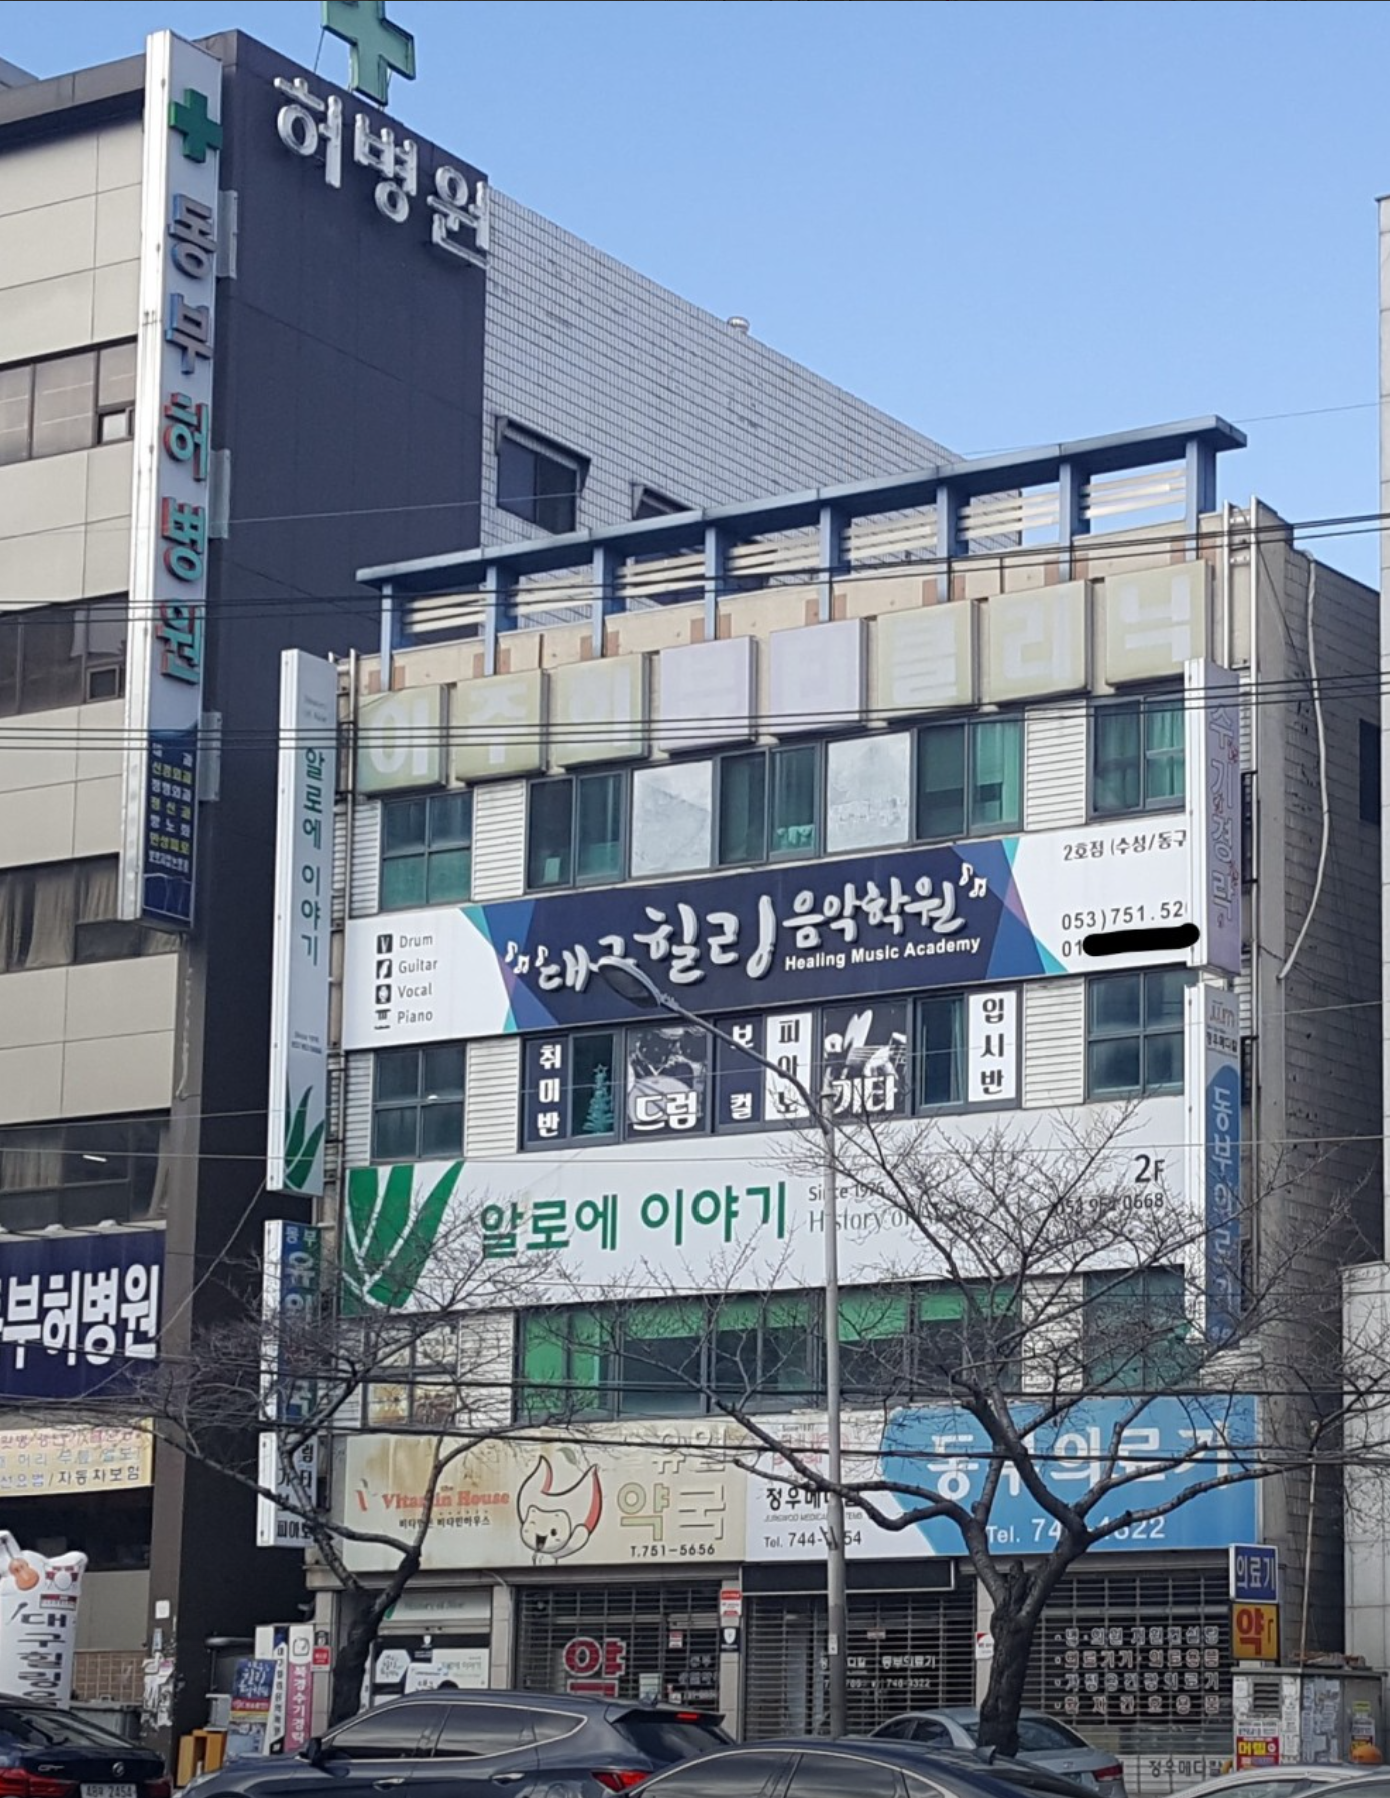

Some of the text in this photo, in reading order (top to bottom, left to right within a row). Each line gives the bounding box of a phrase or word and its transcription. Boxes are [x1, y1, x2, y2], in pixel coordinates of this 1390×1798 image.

[273, 77, 489, 270] 허병원
[303, 747, 325, 851] 알로에
[1063, 840, 1104, 861] 2호점
[300, 865, 322, 967] 이야기
[633, 895, 777, 985] 힐링
[783, 874, 967, 948] 음악학원
[1062, 900, 1188, 931] 053)751.52
[399, 933, 433, 947] Drum
[785, 935, 981, 972] Healing Music Academy
[398, 957, 437, 975] Guitar
[397, 985, 432, 998] Vocal
[397, 1010, 433, 1024] Piano
[981, 998, 1004, 1095] 입시반
[537, 1044, 562, 1138] 취미반
[833, 1076, 897, 1114] 기타
[633, 1091, 697, 1131] 드럼
[1133, 1153, 1165, 1184] 2F
[808, 1183, 848, 1201] Sice
[481, 1181, 786, 1259] 알로에 이야기
[809, 1208, 884, 1234] Hstory
[0, 1263, 159, 1369] 부허병원
[457, 1490, 511, 1506] House
[617, 1481, 726, 1541] 약국
[766, 1486, 862, 1511] 정우메
[631, 1543, 716, 1557] T.751-5656
[788, 1530, 862, 1547] 744-54
[988, 1525, 1020, 1544] Tel.
[1236, 1554, 1276, 1591] 의료기
[1236, 1606, 1266, 1657] 약
